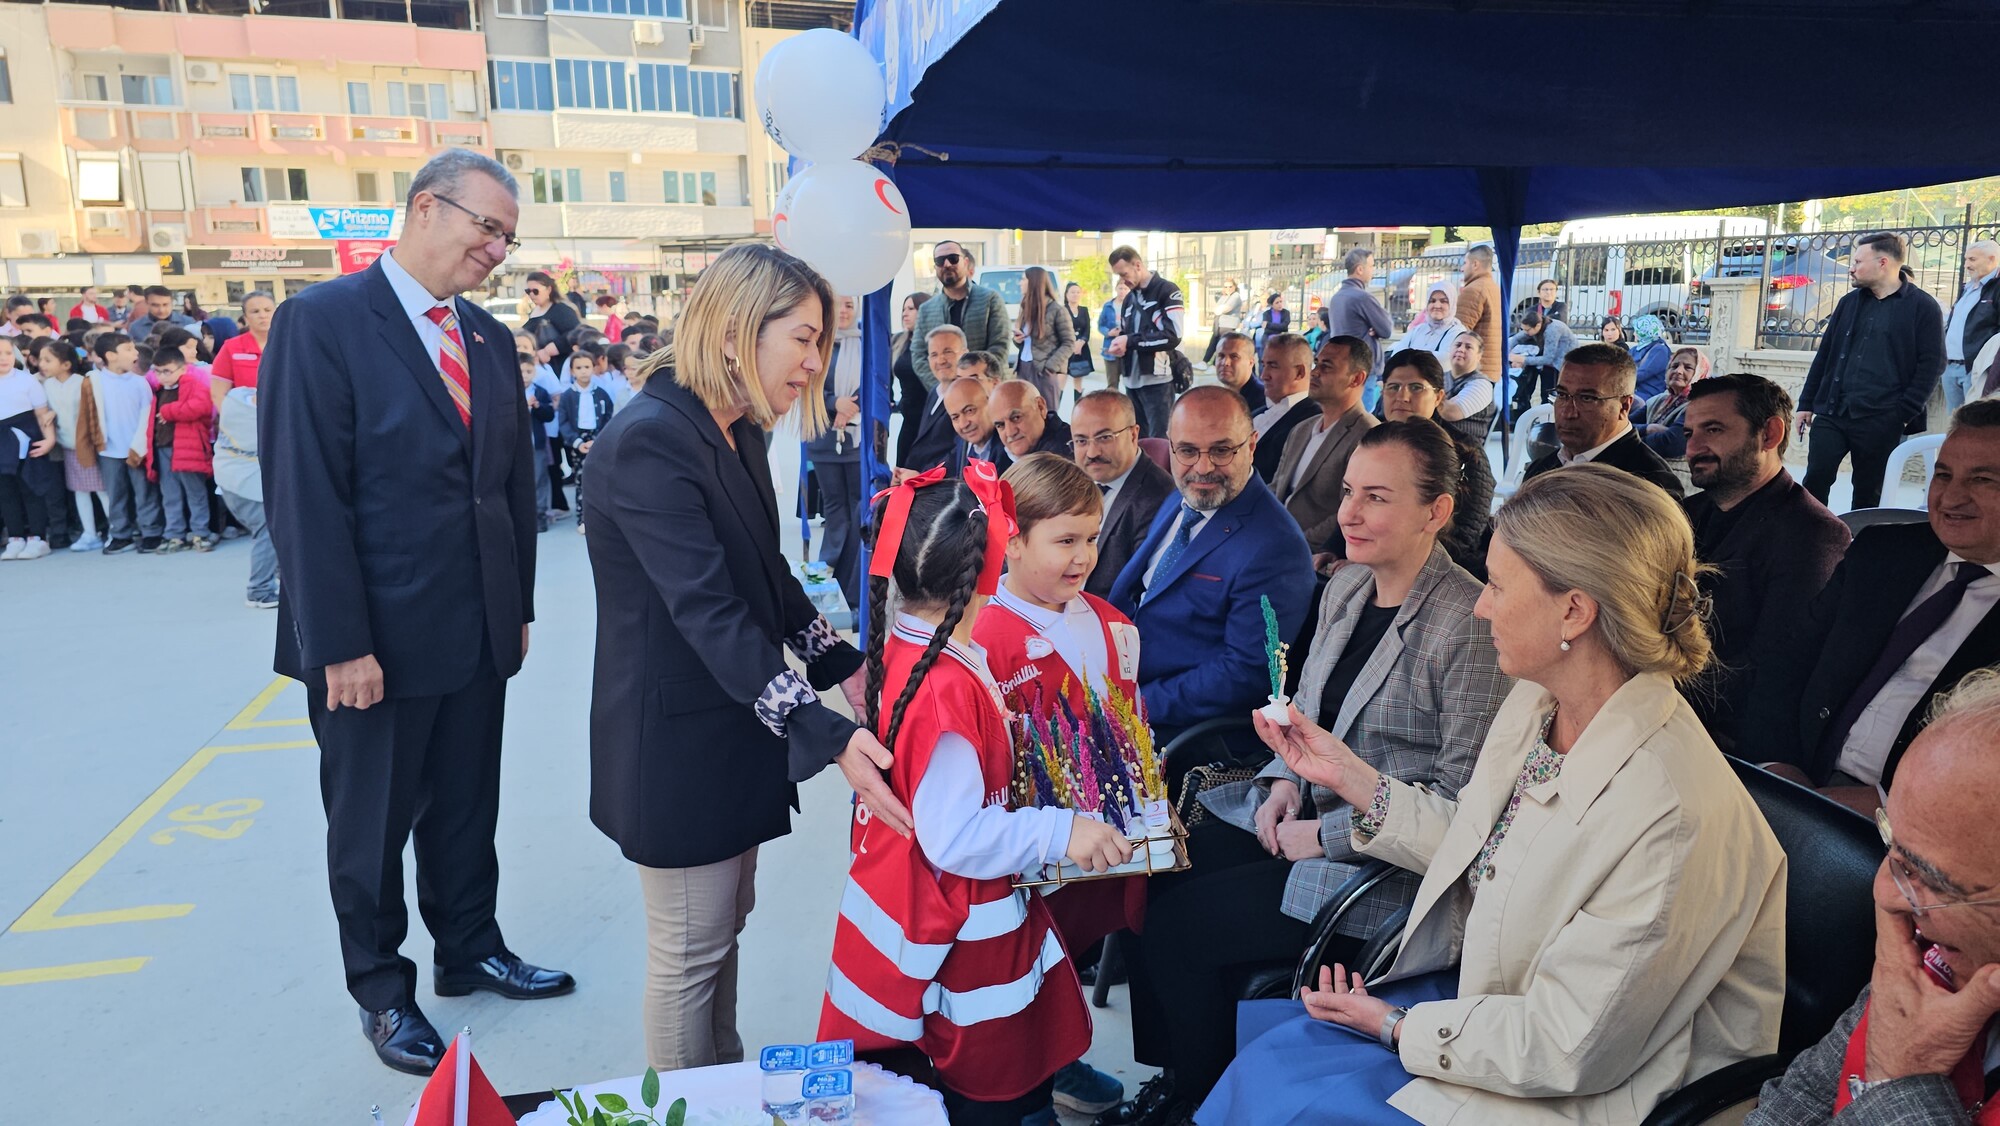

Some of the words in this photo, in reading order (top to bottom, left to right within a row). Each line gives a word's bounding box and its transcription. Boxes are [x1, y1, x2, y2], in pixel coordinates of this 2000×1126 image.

[341, 209, 390, 225] Prizma
[998, 663, 1043, 695] önüllü
[149, 797, 265, 846] 26
